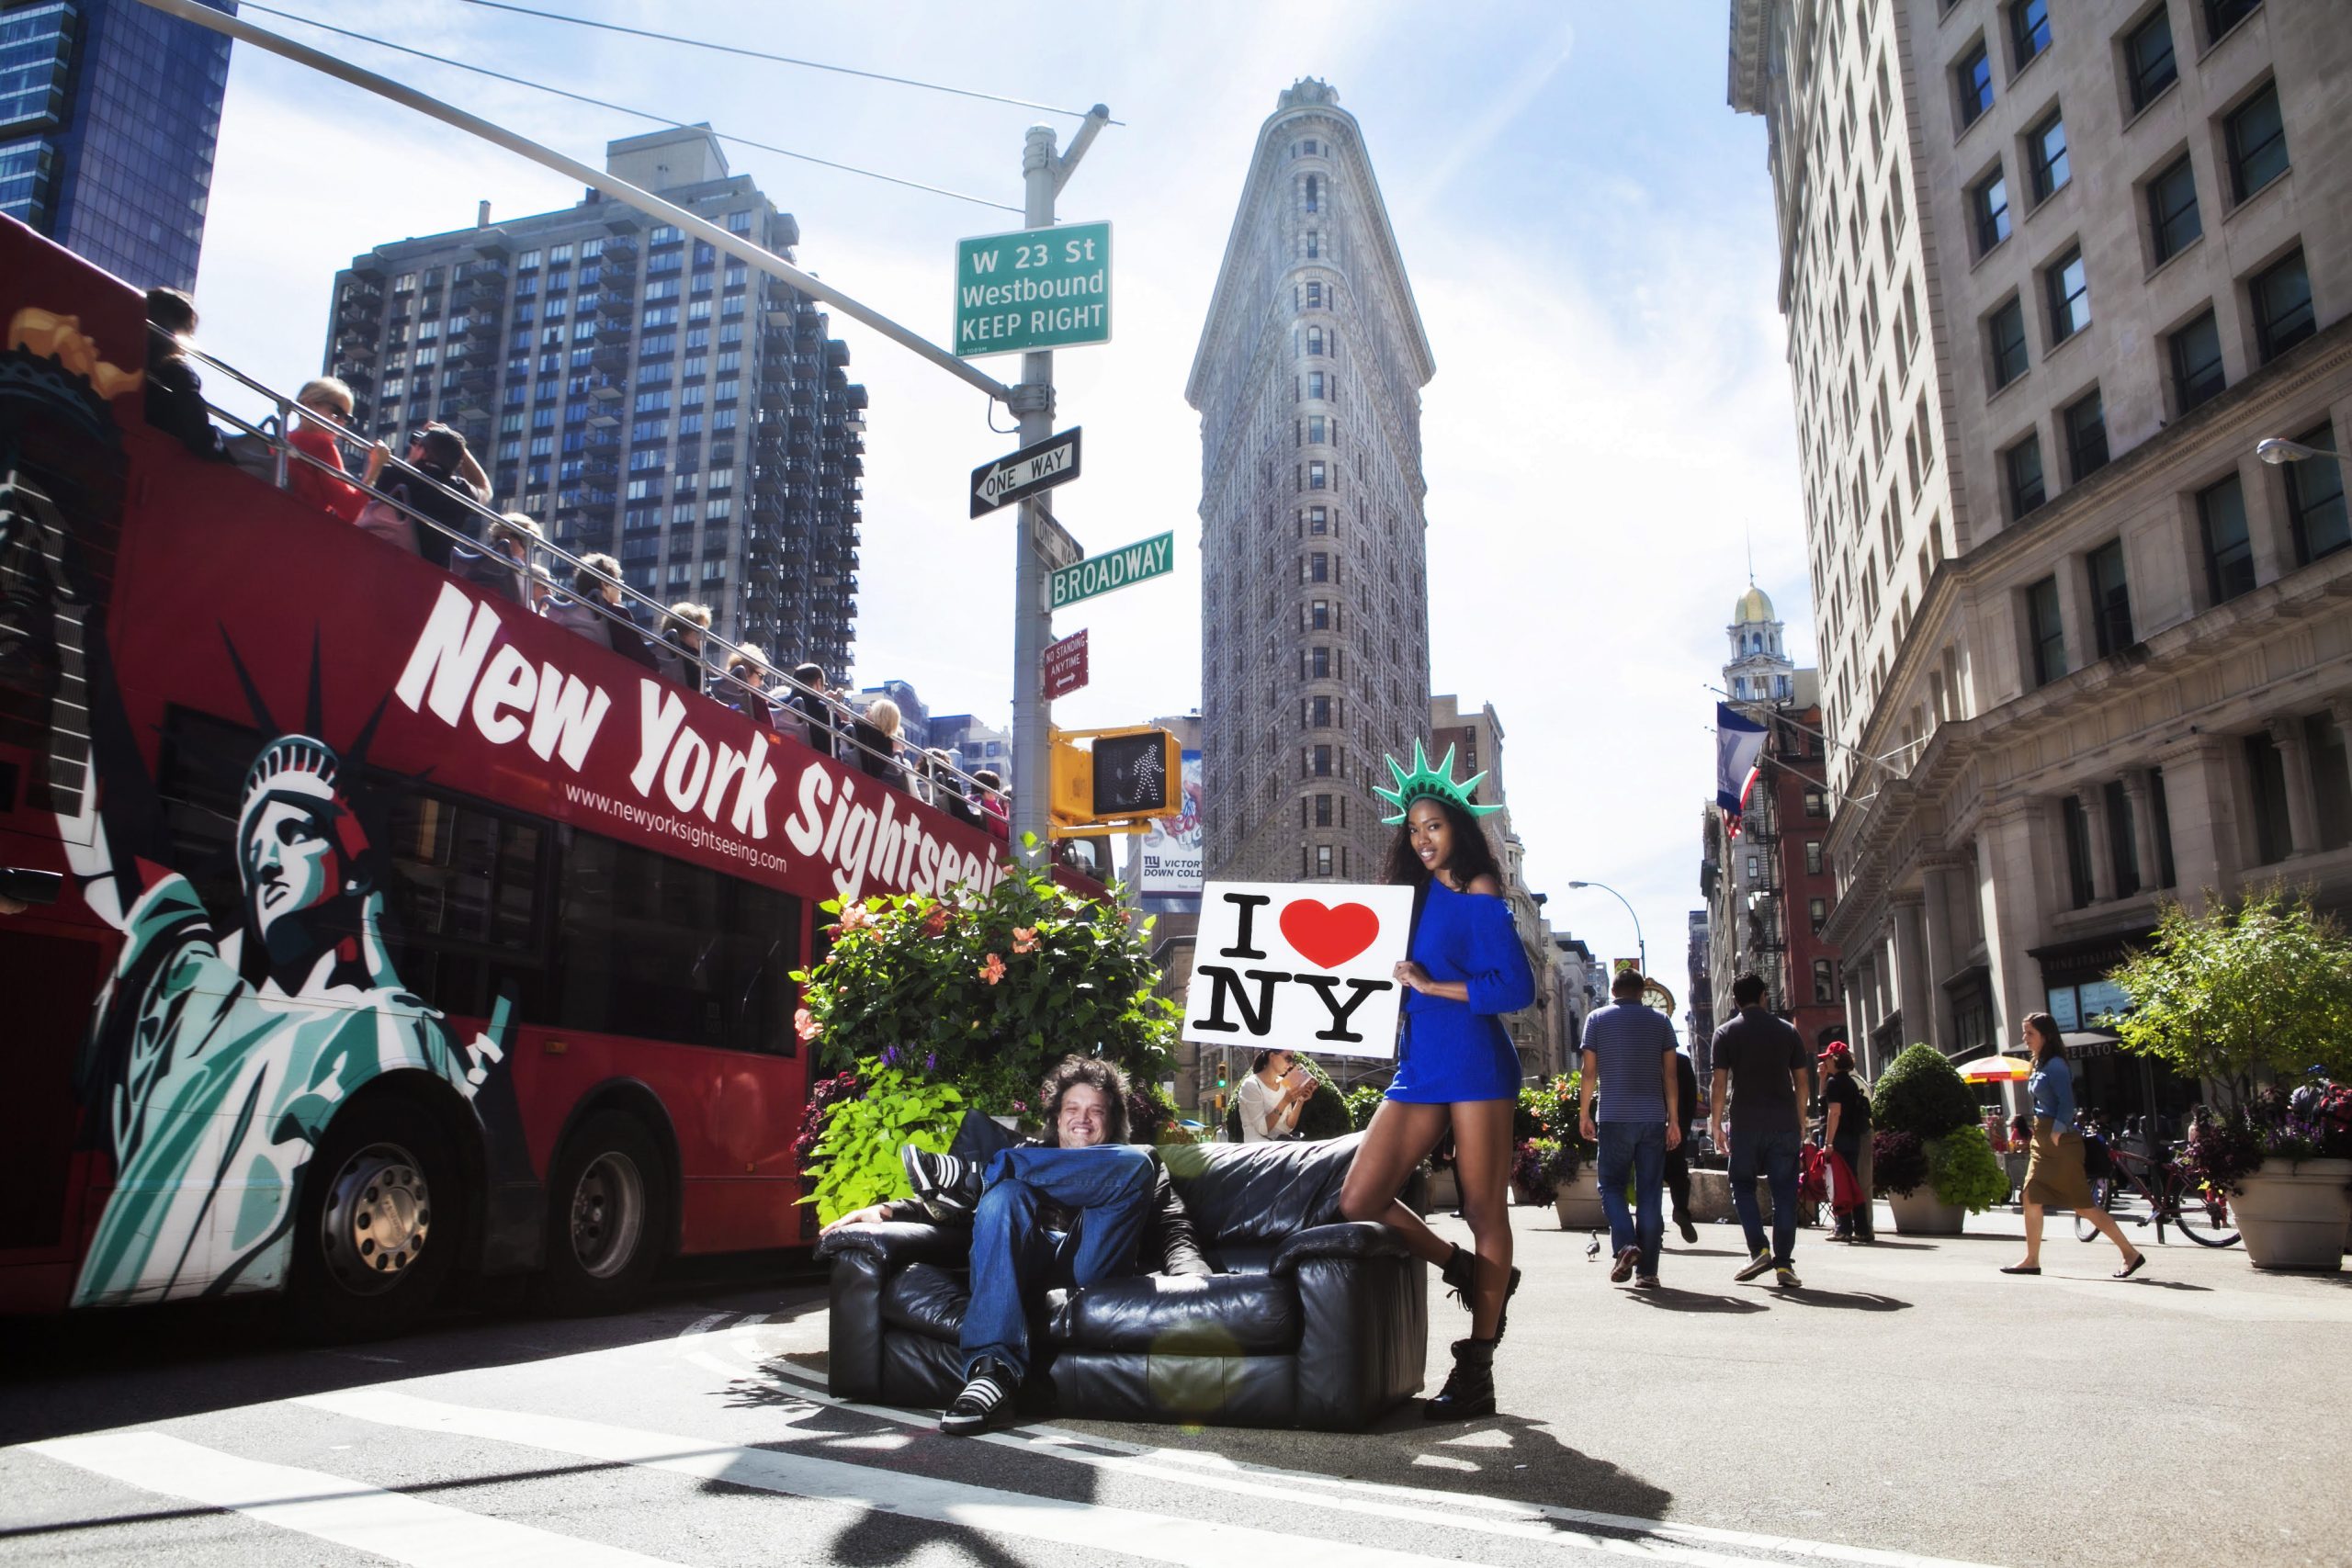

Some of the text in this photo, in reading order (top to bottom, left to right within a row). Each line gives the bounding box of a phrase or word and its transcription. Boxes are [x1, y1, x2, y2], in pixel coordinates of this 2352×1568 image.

[973, 238, 1095, 274] W 23 St
[963, 269, 1103, 309] Westbound
[962, 304, 1103, 342] KEEP RIGHT
[986, 448, 1065, 497] ONE WAY
[1039, 520, 1055, 552] ONE
[1054, 537, 1168, 604] BROADWAY
[1046, 636, 1085, 664] NO STANDING
[1050, 653, 1080, 676] ANYTIME
[394, 581, 611, 772] New
[630, 679, 778, 840] York
[565, 783, 787, 874] www.newyorksightseeing.com
[1144, 869, 1174, 877] DOWN
[1164, 860, 1202, 868] VICTOR
[1220, 893, 1270, 959] I
[1193, 965, 1393, 1043] NY
